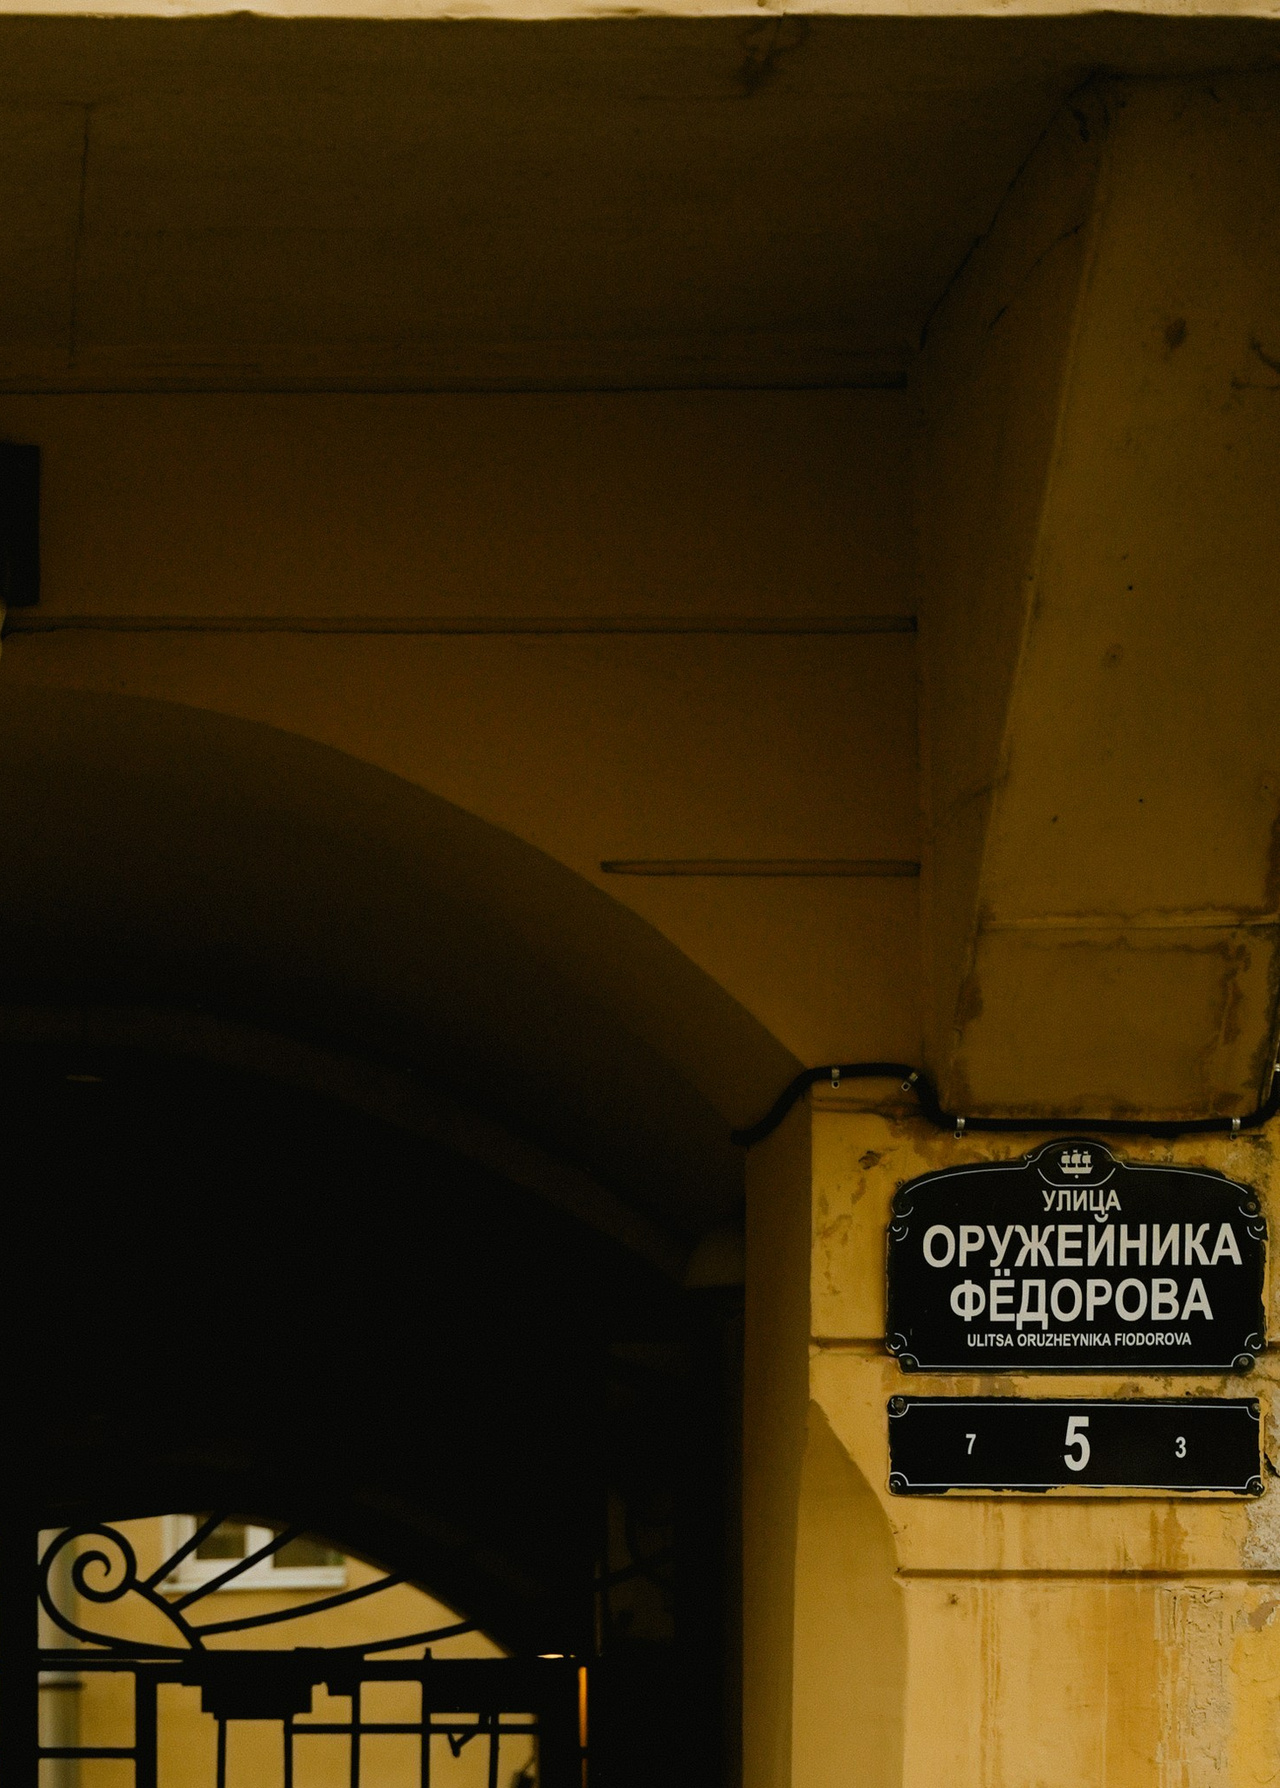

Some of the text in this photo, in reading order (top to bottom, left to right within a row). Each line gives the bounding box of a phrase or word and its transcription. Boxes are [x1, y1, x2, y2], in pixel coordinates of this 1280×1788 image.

[1042, 1190, 1121, 1212] УЛИЦА
[923, 1213, 1243, 1267] ОРУЖЕЙНИКА
[950, 1269, 1214, 1330] ФЁДОРОВА
[967, 1332, 1192, 1347] ULITSA ORUZHEYNIKA FIODOROVA
[965, 1433, 977, 1455] 7
[1063, 1415, 1091, 1471] 5
[1175, 1436, 1187, 1458] 3
